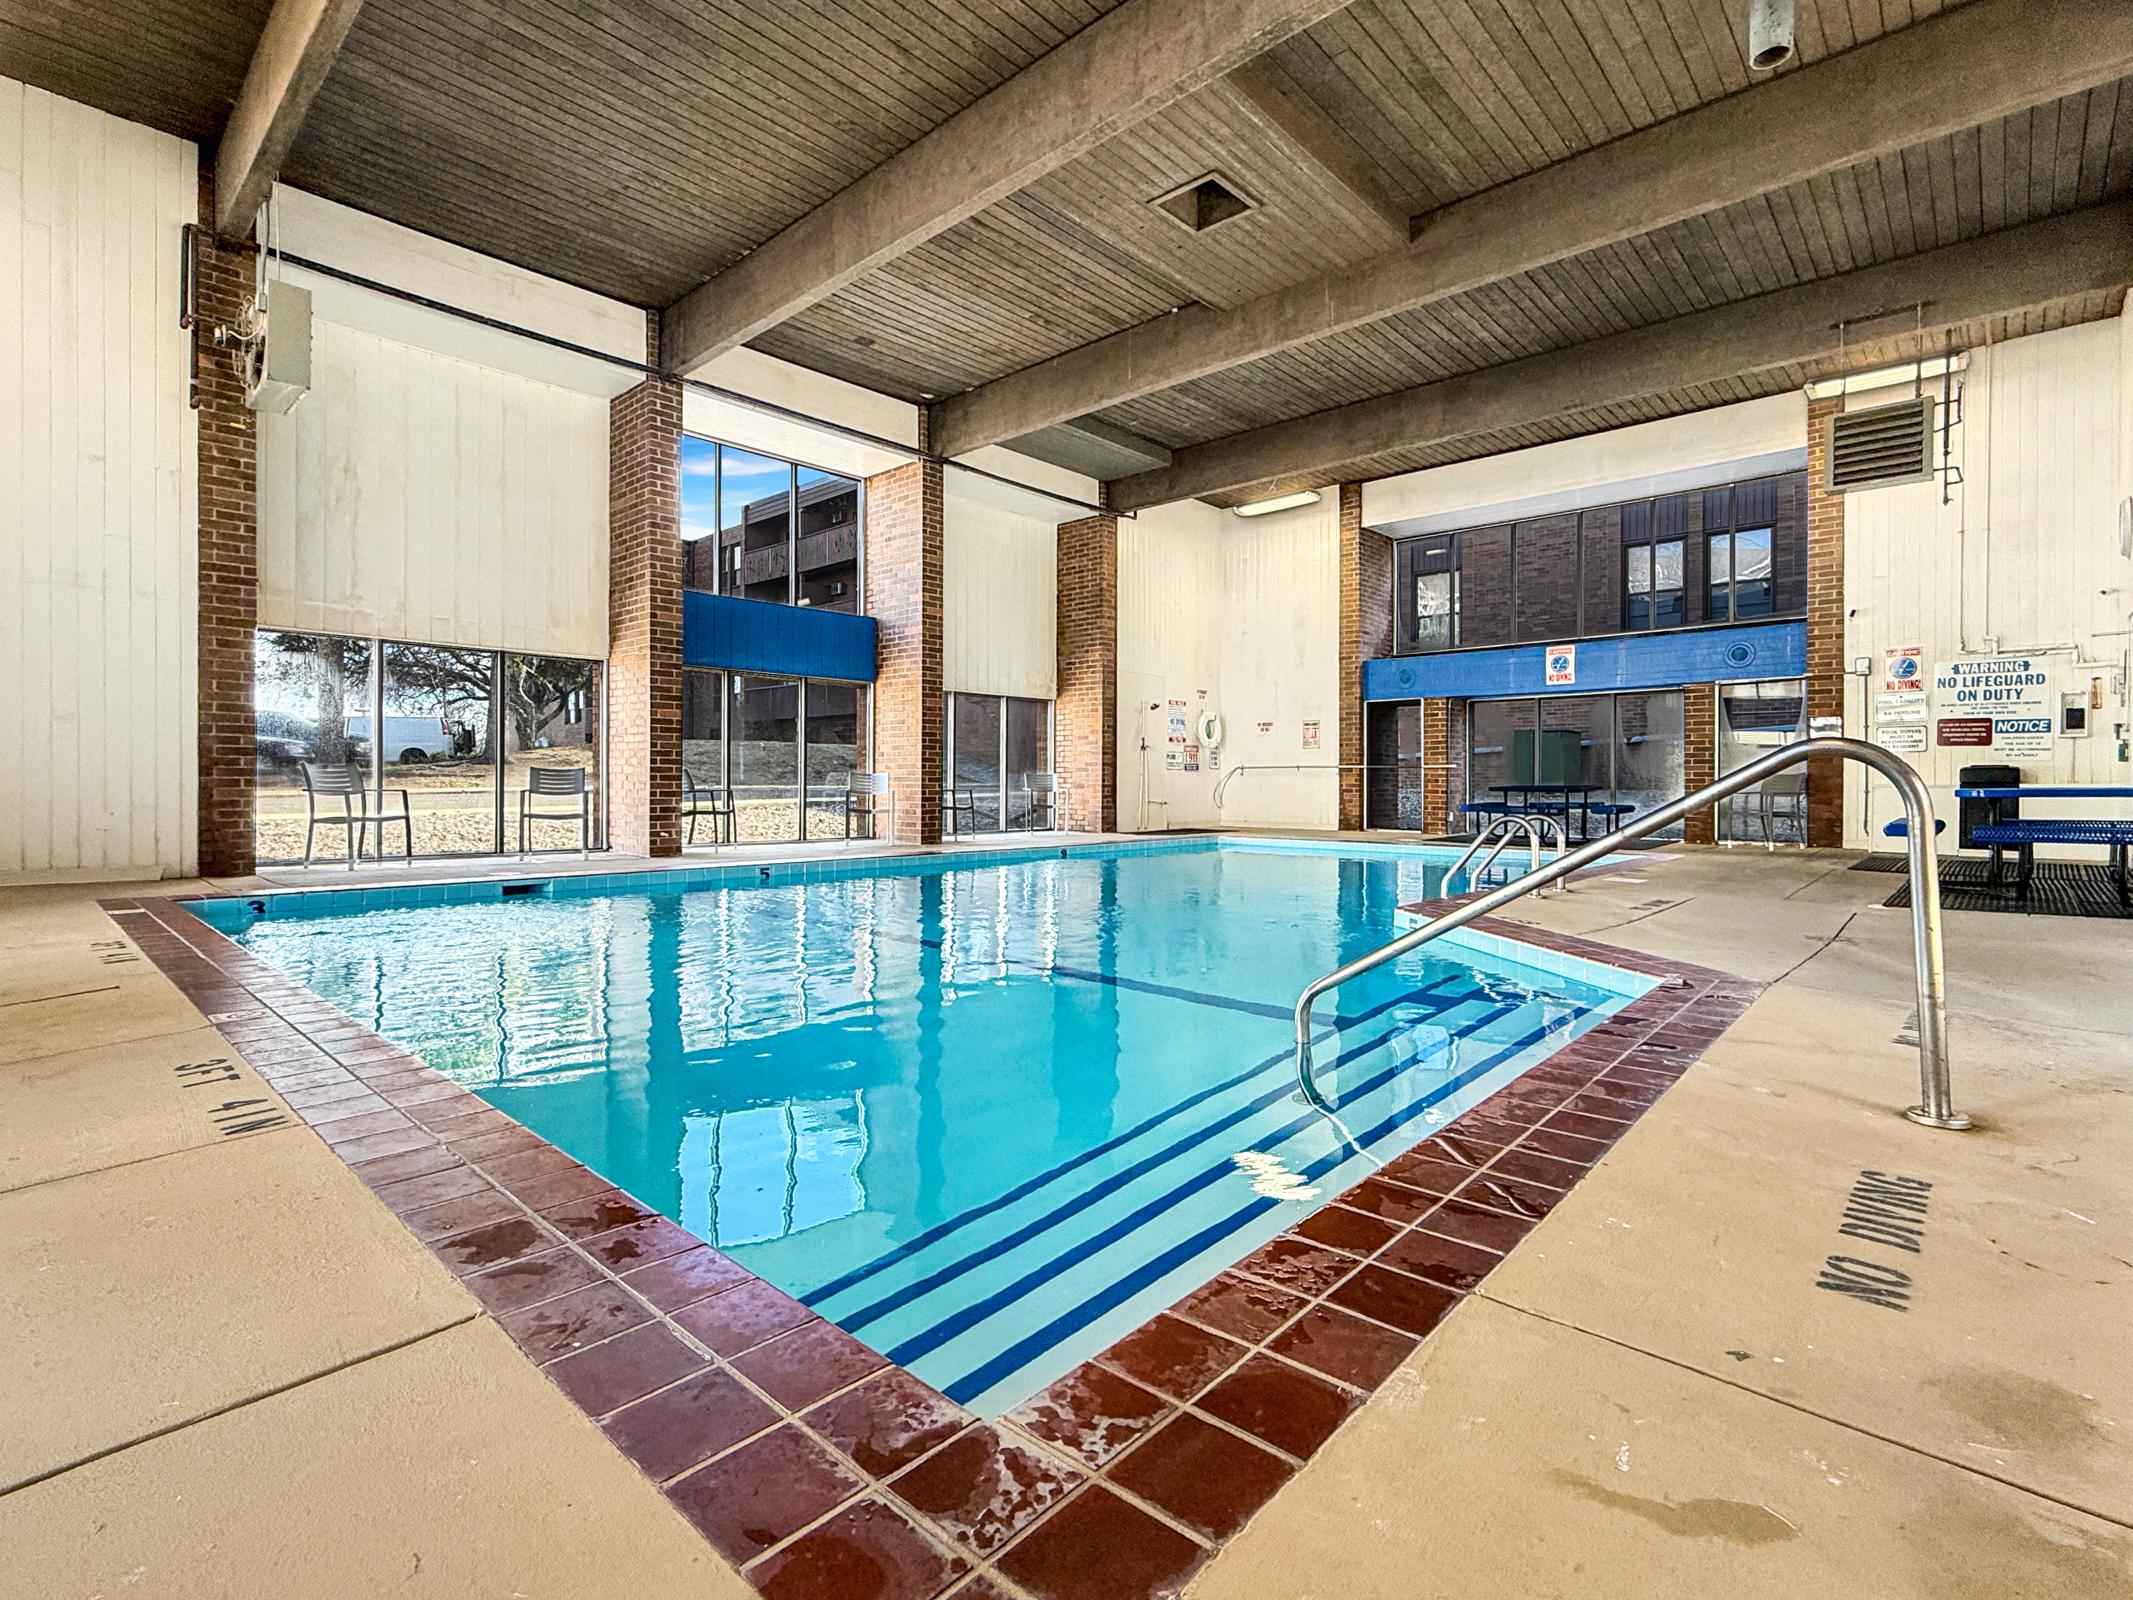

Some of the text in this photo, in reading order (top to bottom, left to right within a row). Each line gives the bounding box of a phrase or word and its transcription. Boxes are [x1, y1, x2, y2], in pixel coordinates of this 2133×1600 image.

[1958, 661, 2025, 674] WARNING
[1887, 681, 1895, 690] NO
[1937, 673, 2046, 688] NO LIFEGUARD
[1957, 688, 2024, 701] ON DUTY
[1997, 720, 2049, 733] NOTICE
[760, 868, 770, 880] 5
[247, 900, 266, 914] 3
[1816, 1171, 1932, 1313] NO DIVING
